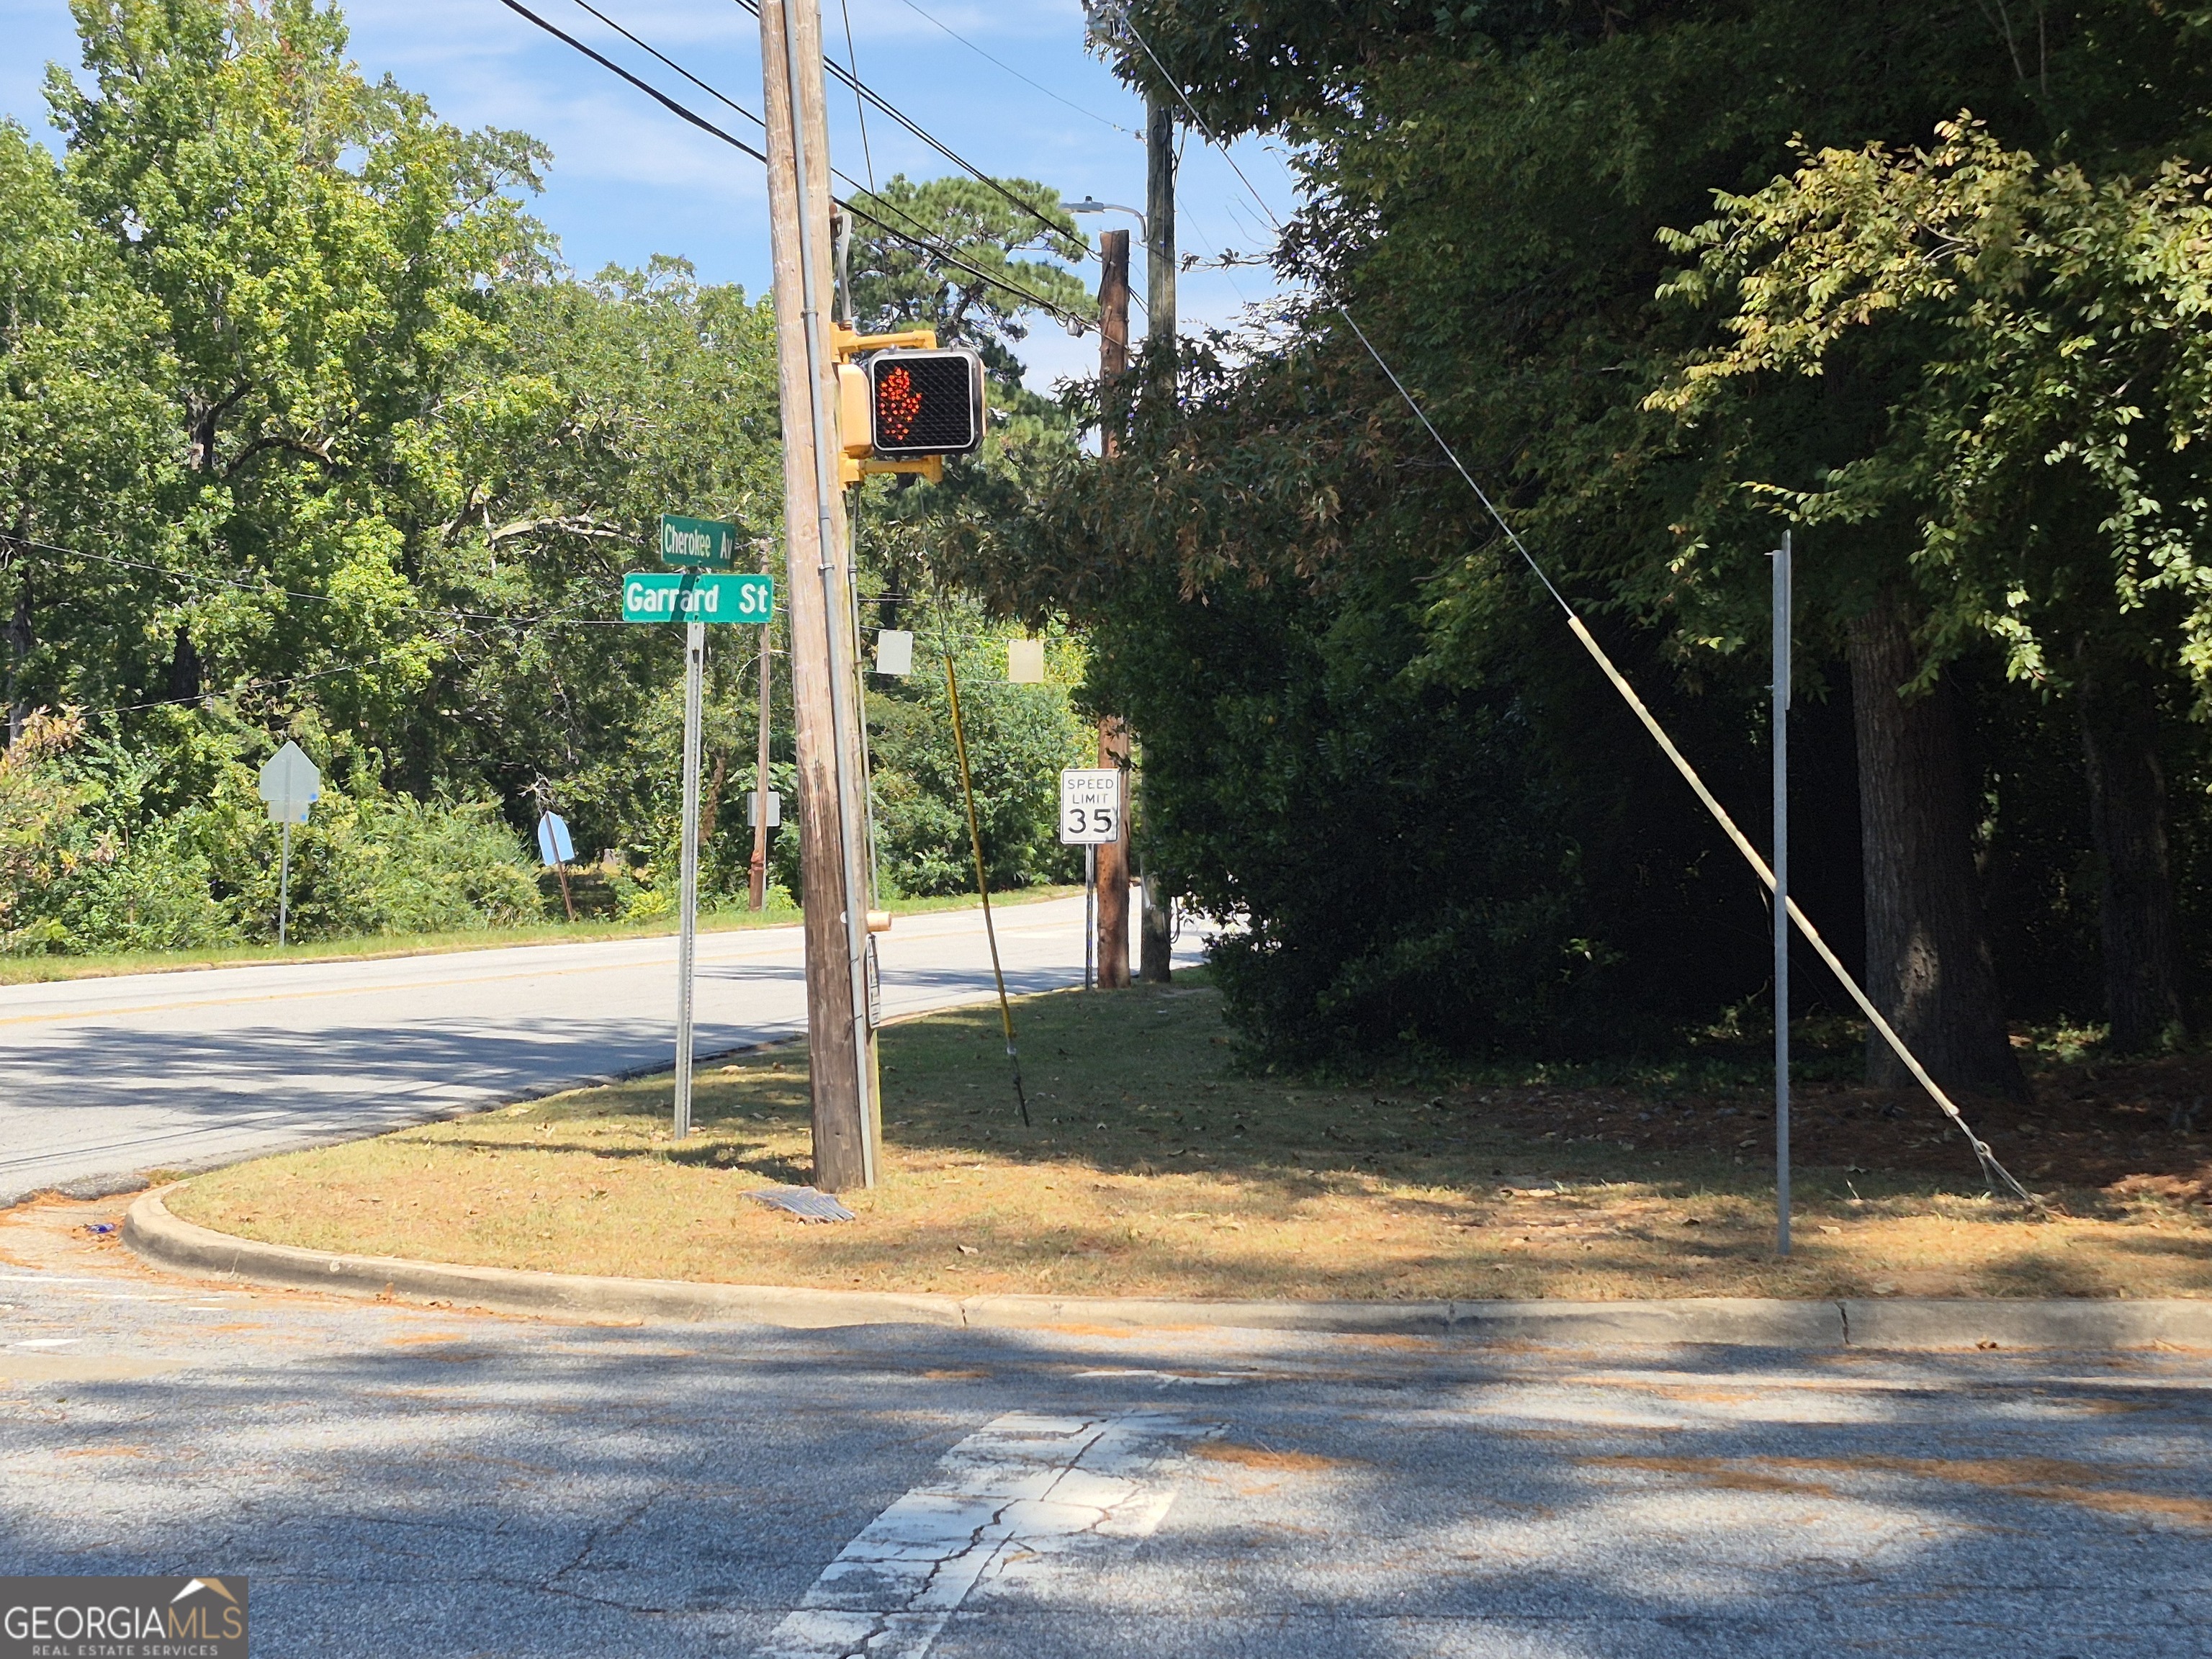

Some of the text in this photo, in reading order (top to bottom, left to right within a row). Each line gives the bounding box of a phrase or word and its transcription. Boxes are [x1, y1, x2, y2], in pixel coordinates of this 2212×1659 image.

[665, 523, 732, 559] Cherokee Av
[626, 582, 768, 613] Garrard St
[1067, 779, 1114, 789] SPEED
[1072, 793, 1109, 804] LIMIT
[1067, 808, 1112, 834] 35
